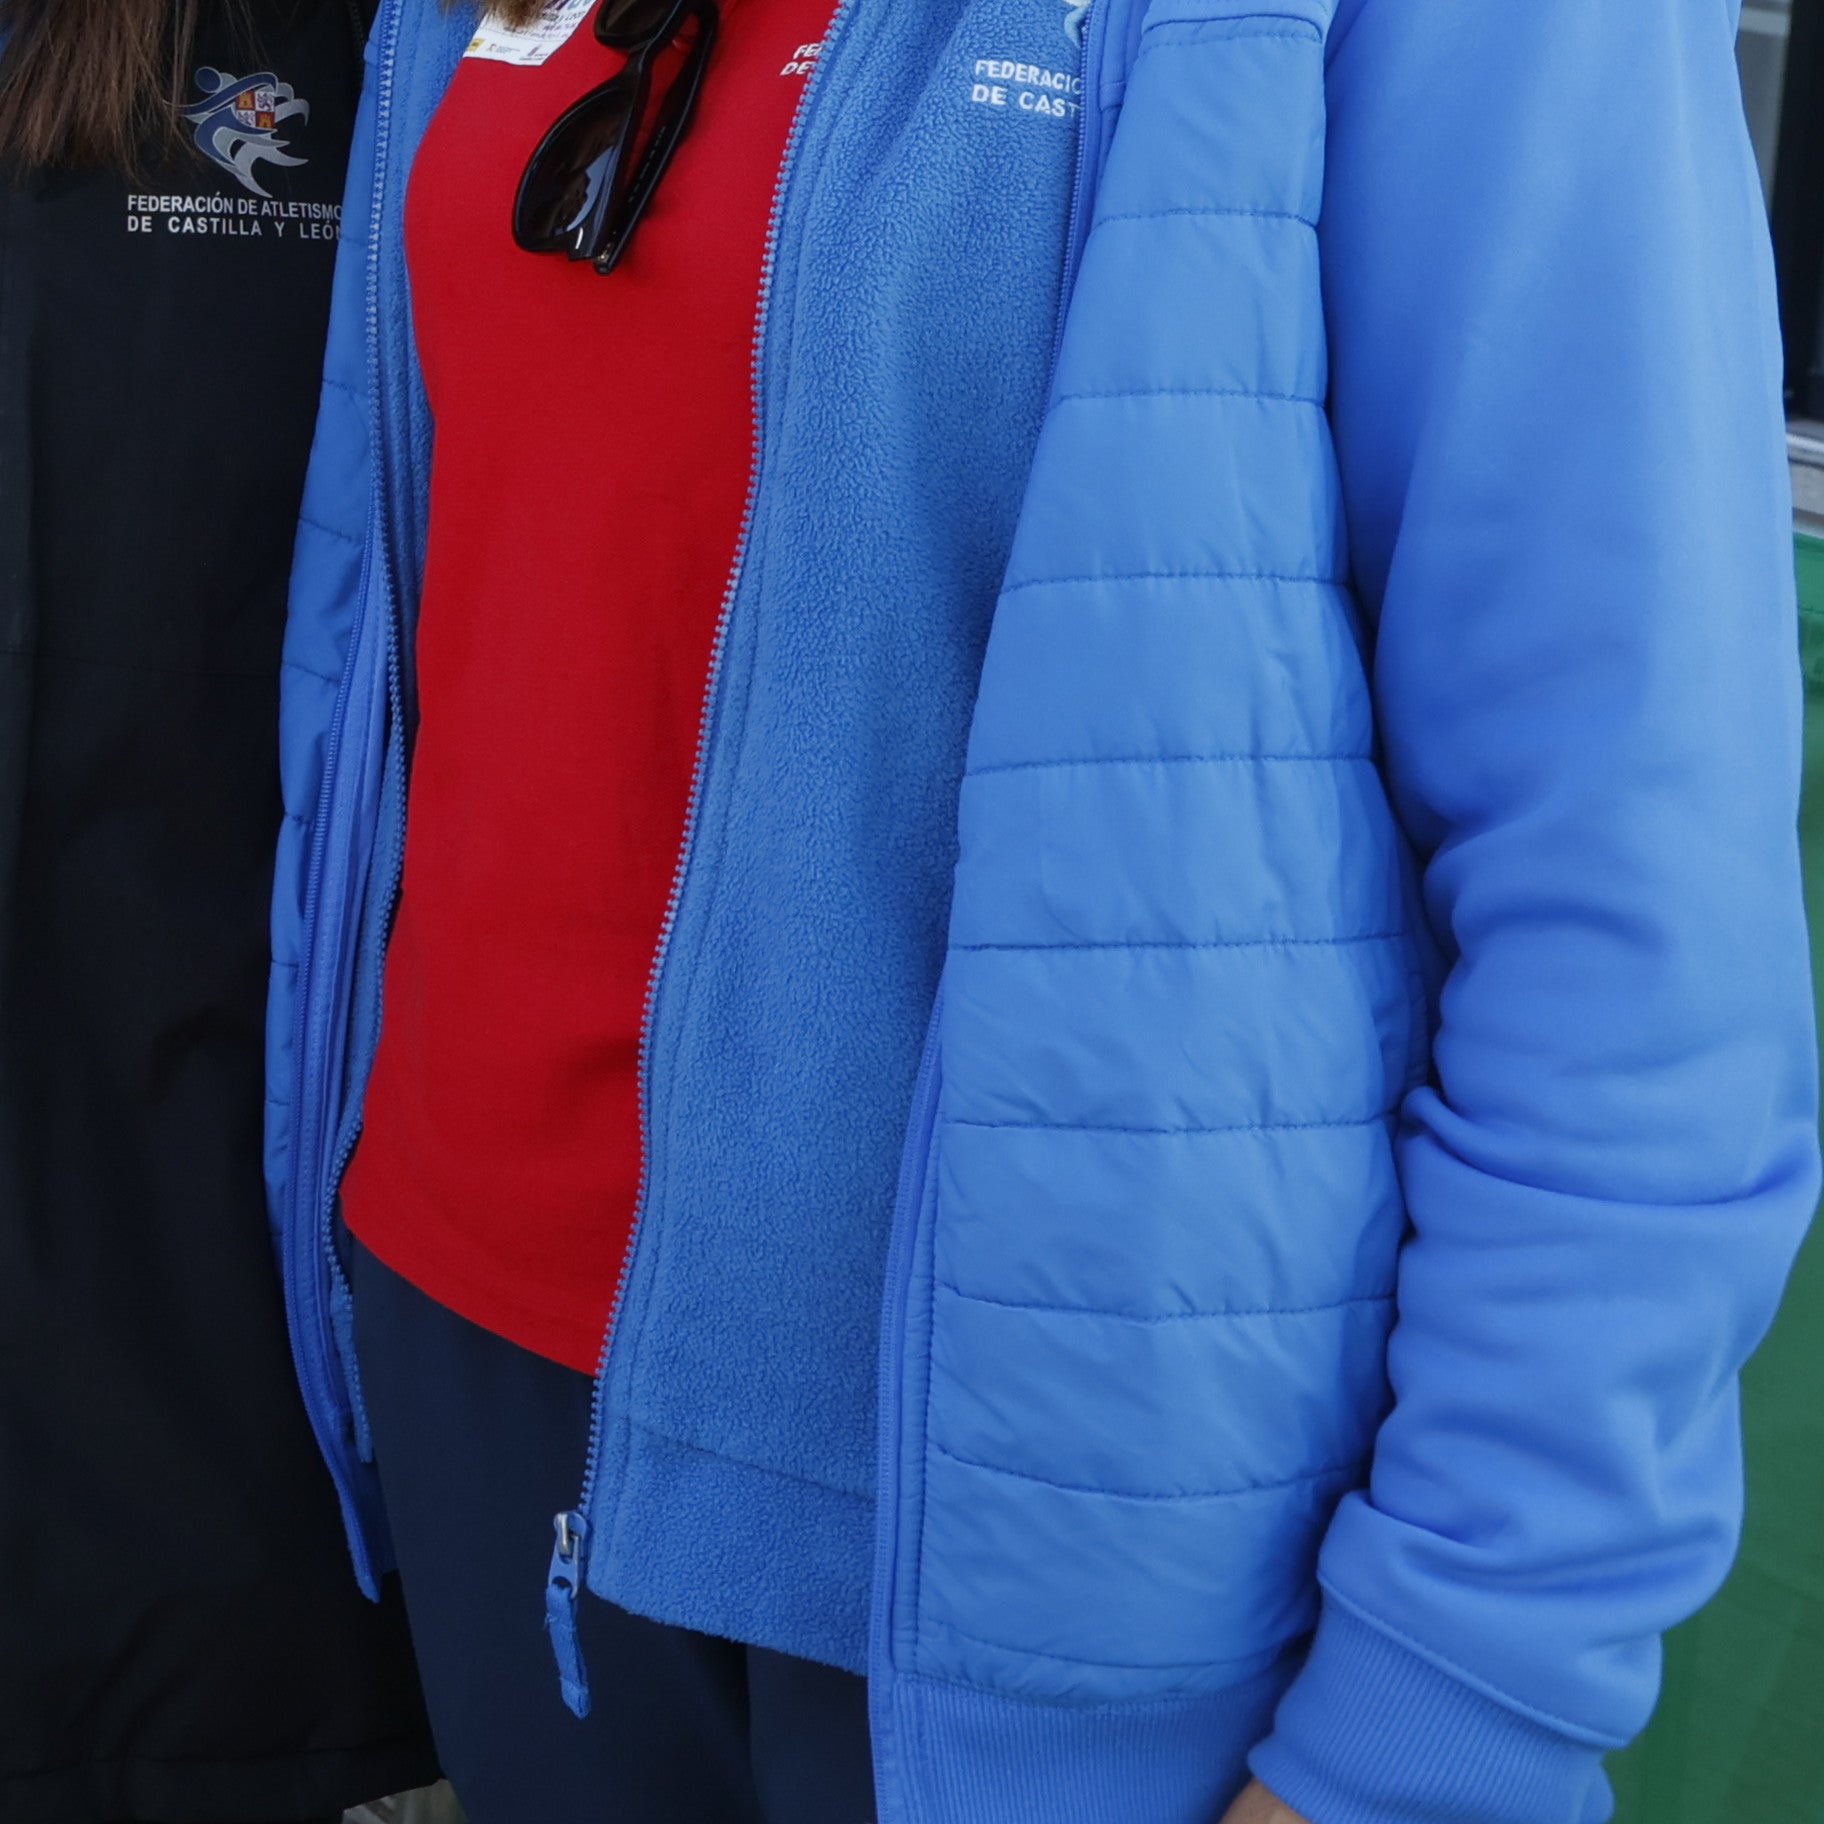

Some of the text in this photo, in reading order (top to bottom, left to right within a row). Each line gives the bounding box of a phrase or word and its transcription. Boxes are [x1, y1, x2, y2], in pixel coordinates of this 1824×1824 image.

[971, 83, 1008, 106] DE
[127, 190, 234, 214] FEDERACIÓN
[238, 198, 258, 216] DE
[127, 215, 153, 233] DE
[168, 216, 263, 237] CASTILLA
[274, 221, 286, 238] Y
